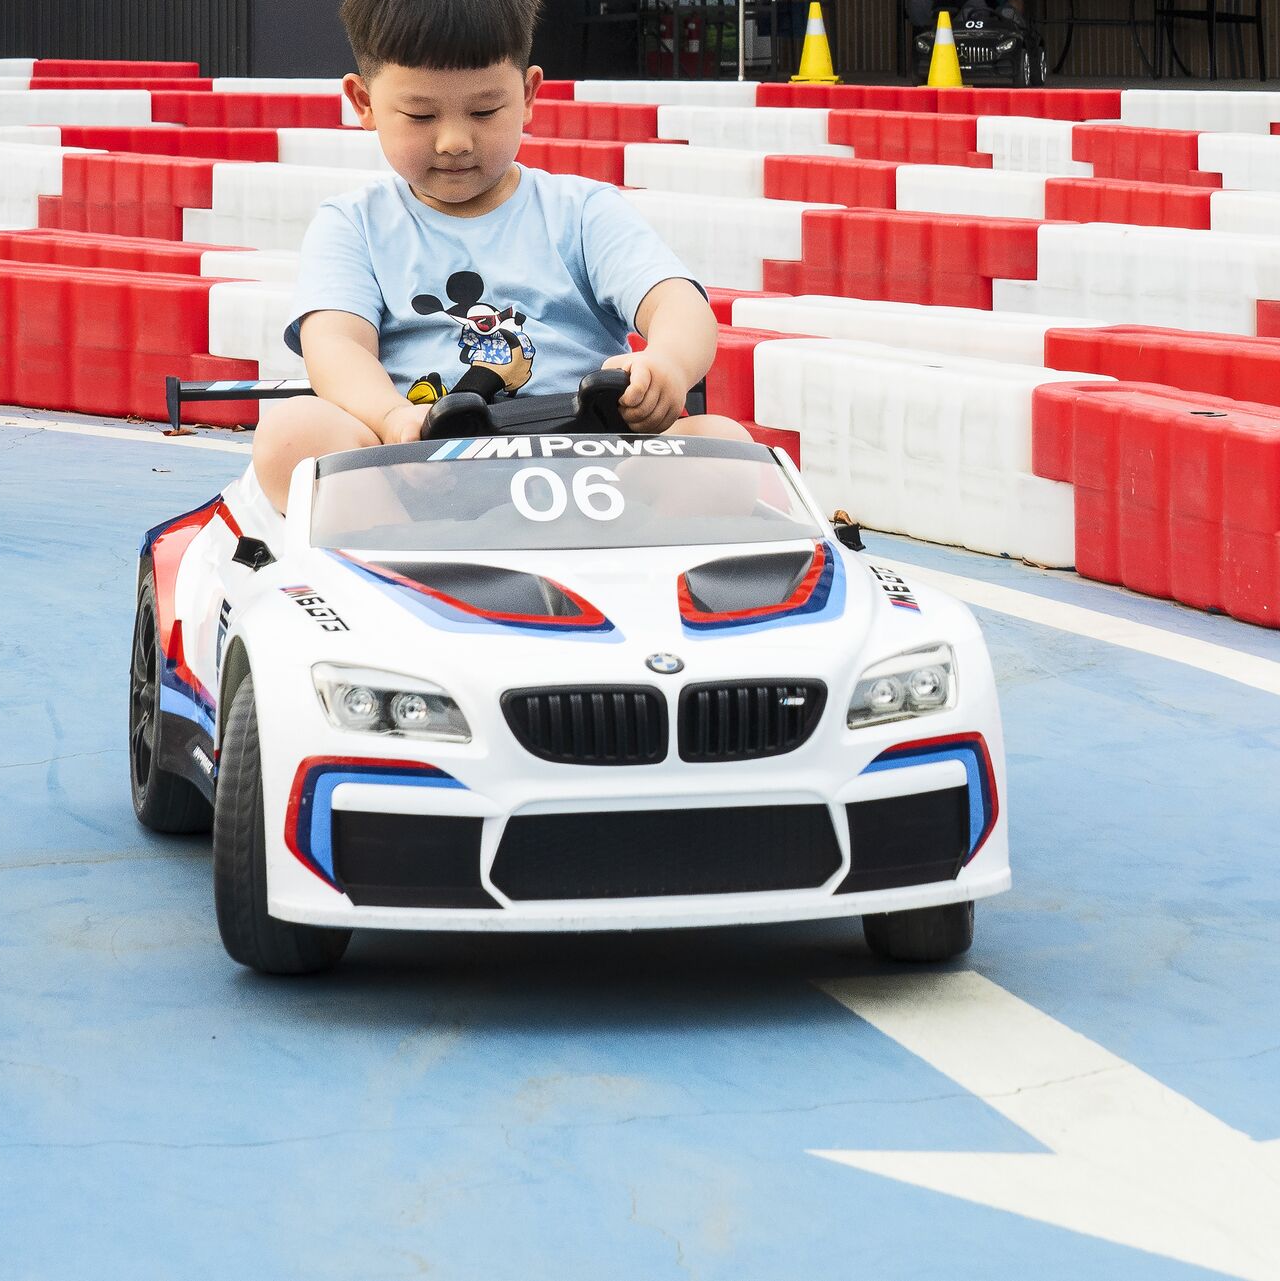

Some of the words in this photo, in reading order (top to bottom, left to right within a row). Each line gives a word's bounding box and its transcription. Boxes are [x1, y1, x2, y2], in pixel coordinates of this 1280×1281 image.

[965, 20, 984, 29] 03
[540, 436, 686, 458] Power
[510, 466, 625, 522] 06
